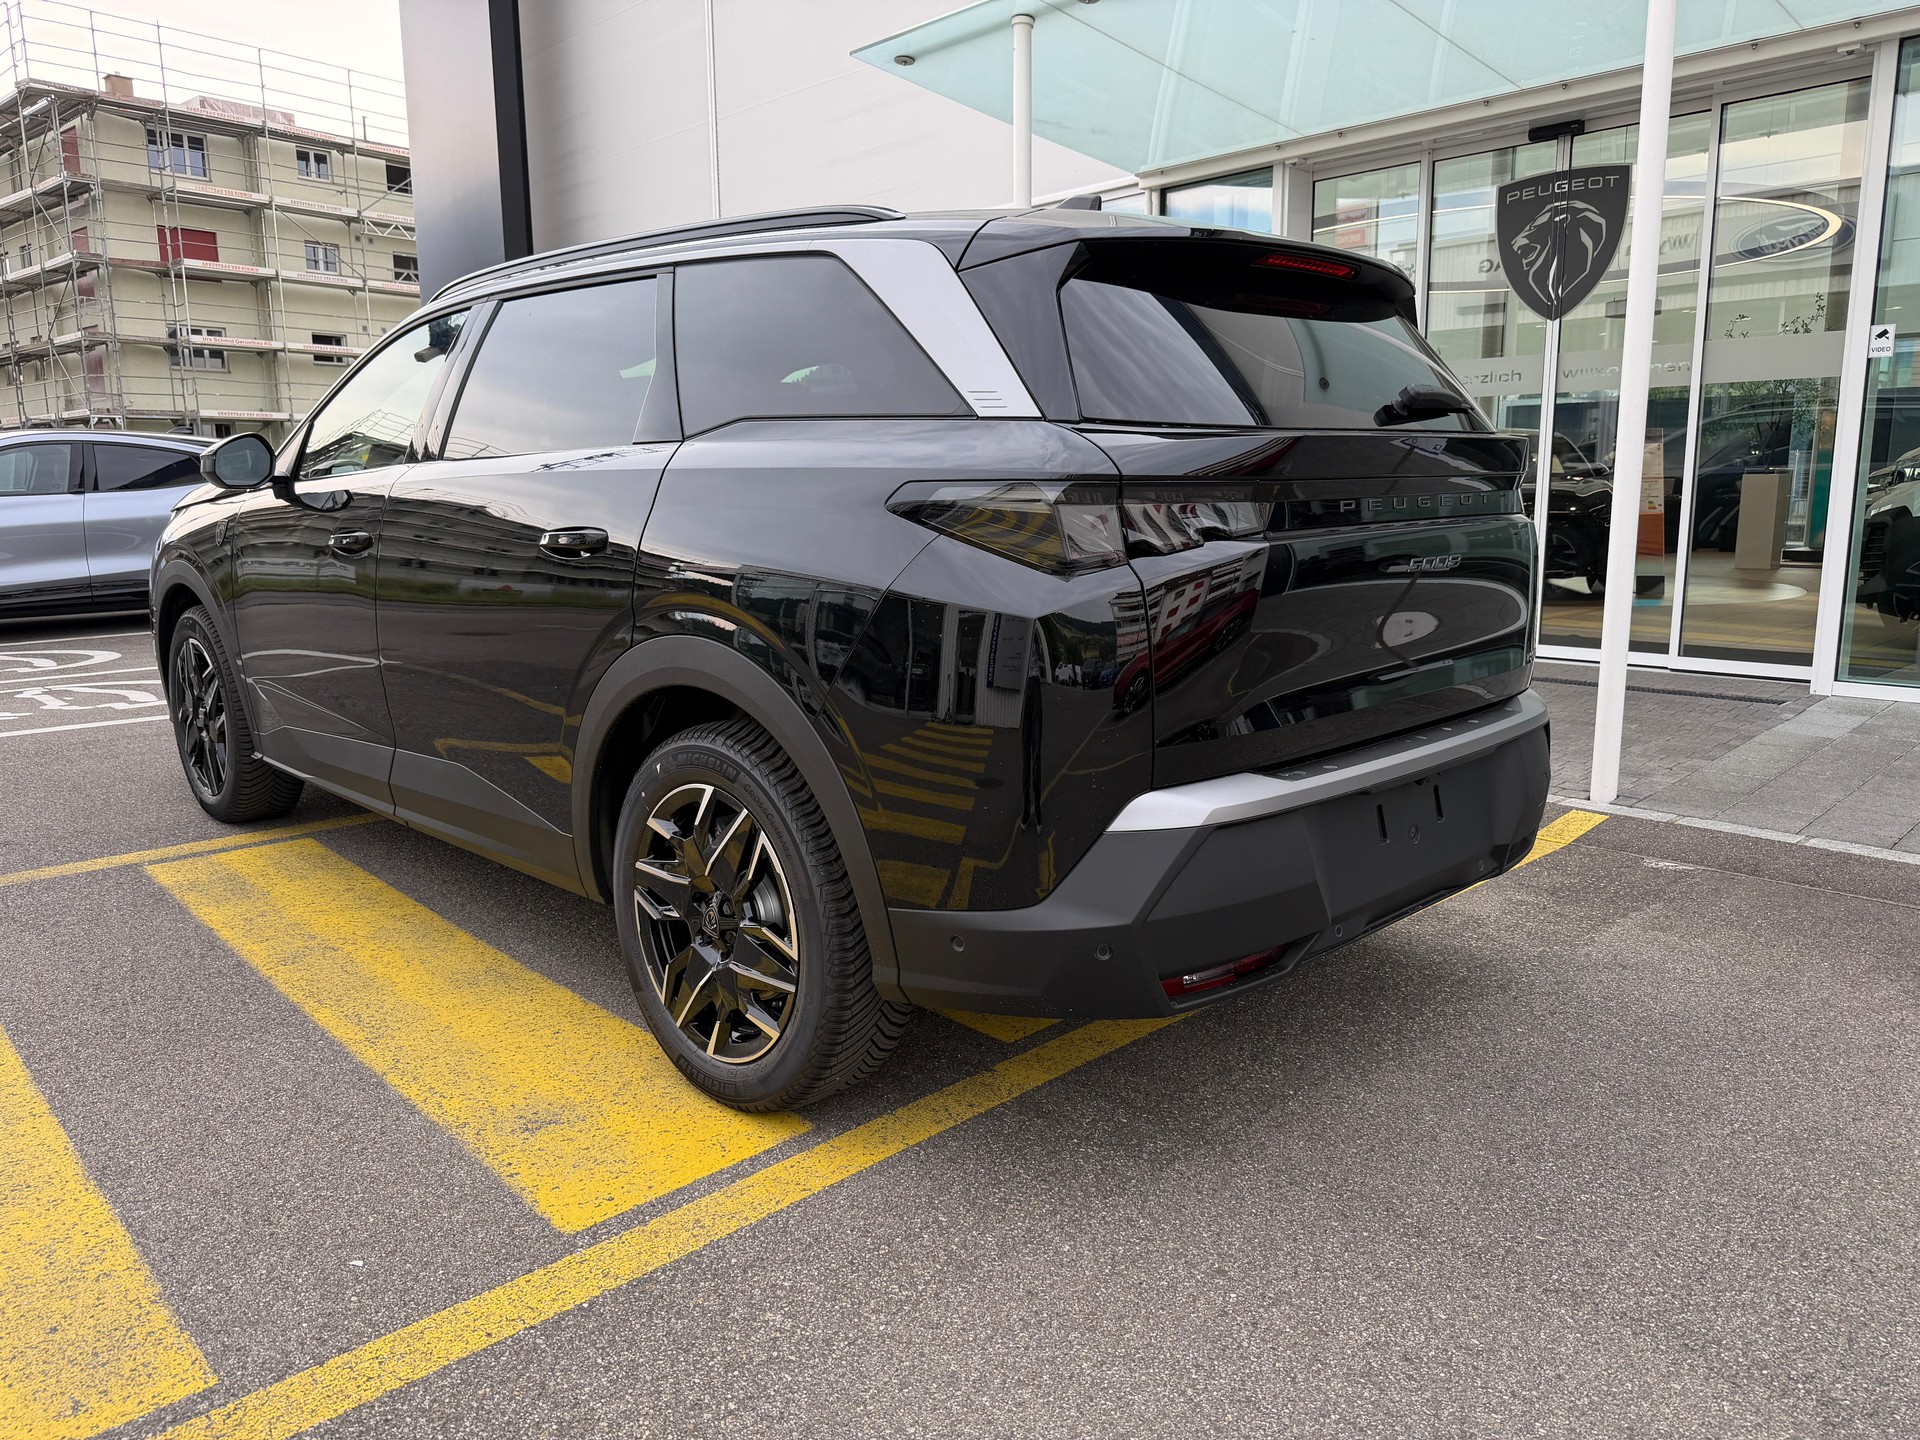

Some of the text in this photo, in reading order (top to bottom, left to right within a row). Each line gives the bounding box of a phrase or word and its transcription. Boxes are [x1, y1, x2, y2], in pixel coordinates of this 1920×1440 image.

[1506, 175, 1620, 205] PEUGEOT
[1460, 361, 1690, 386] erzlich willkomen
[1339, 493, 1491, 513] PEUGEOT
[1407, 554, 1461, 573] 5008
[676, 753, 737, 780] MICHELIN
